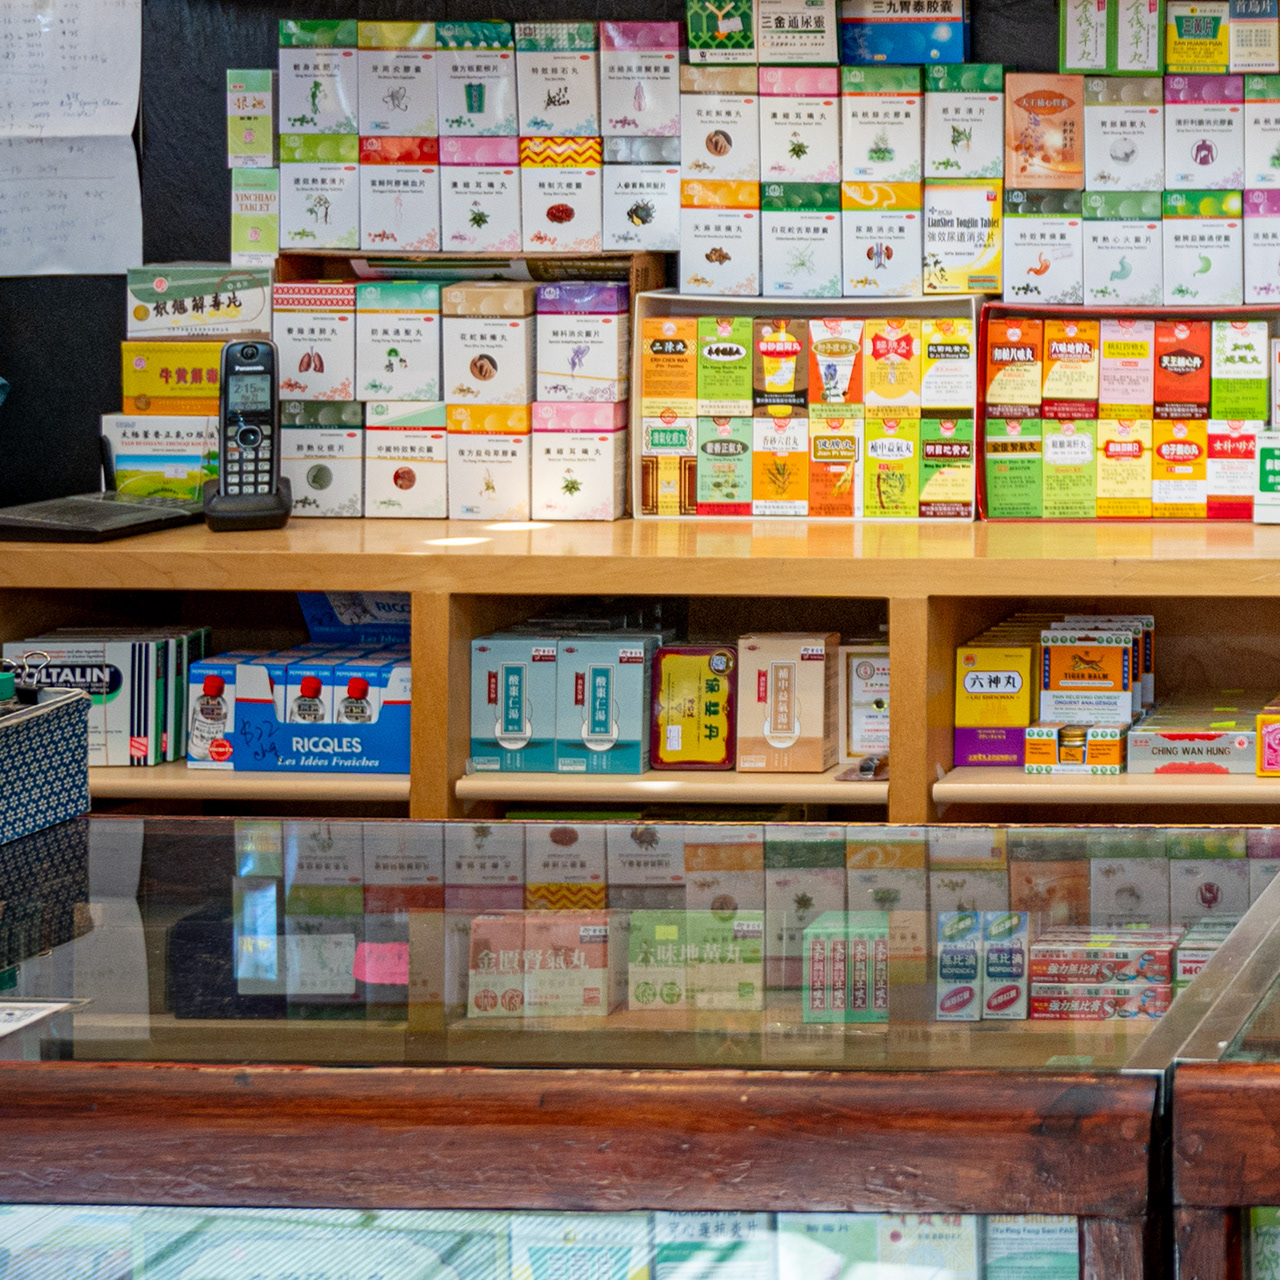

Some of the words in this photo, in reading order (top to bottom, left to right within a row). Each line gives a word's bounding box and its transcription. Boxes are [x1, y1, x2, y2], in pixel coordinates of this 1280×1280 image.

[872, 0, 954, 15] 三九胃泰胶囊
[928, 217, 954, 229] LianShen
[956, 217, 979, 229] Tonglin
[980, 217, 1000, 229] Tablet
[928, 232, 996, 242] 強效尿道消炎片
[654, 340, 686, 352] 二陳丸
[818, 440, 854, 450] 健脾丸
[870, 443, 912, 454] 補中益氣丸
[971, 675, 1017, 689] 六神丸
[292, 737, 362, 754] RICQLES
[300, 756, 328, 767] Idées
[332, 756, 380, 767] Fraîches
[1047, 964, 1100, 974] 強力無比膏
[1048, 1000, 1101, 1012] 強力無比膏
